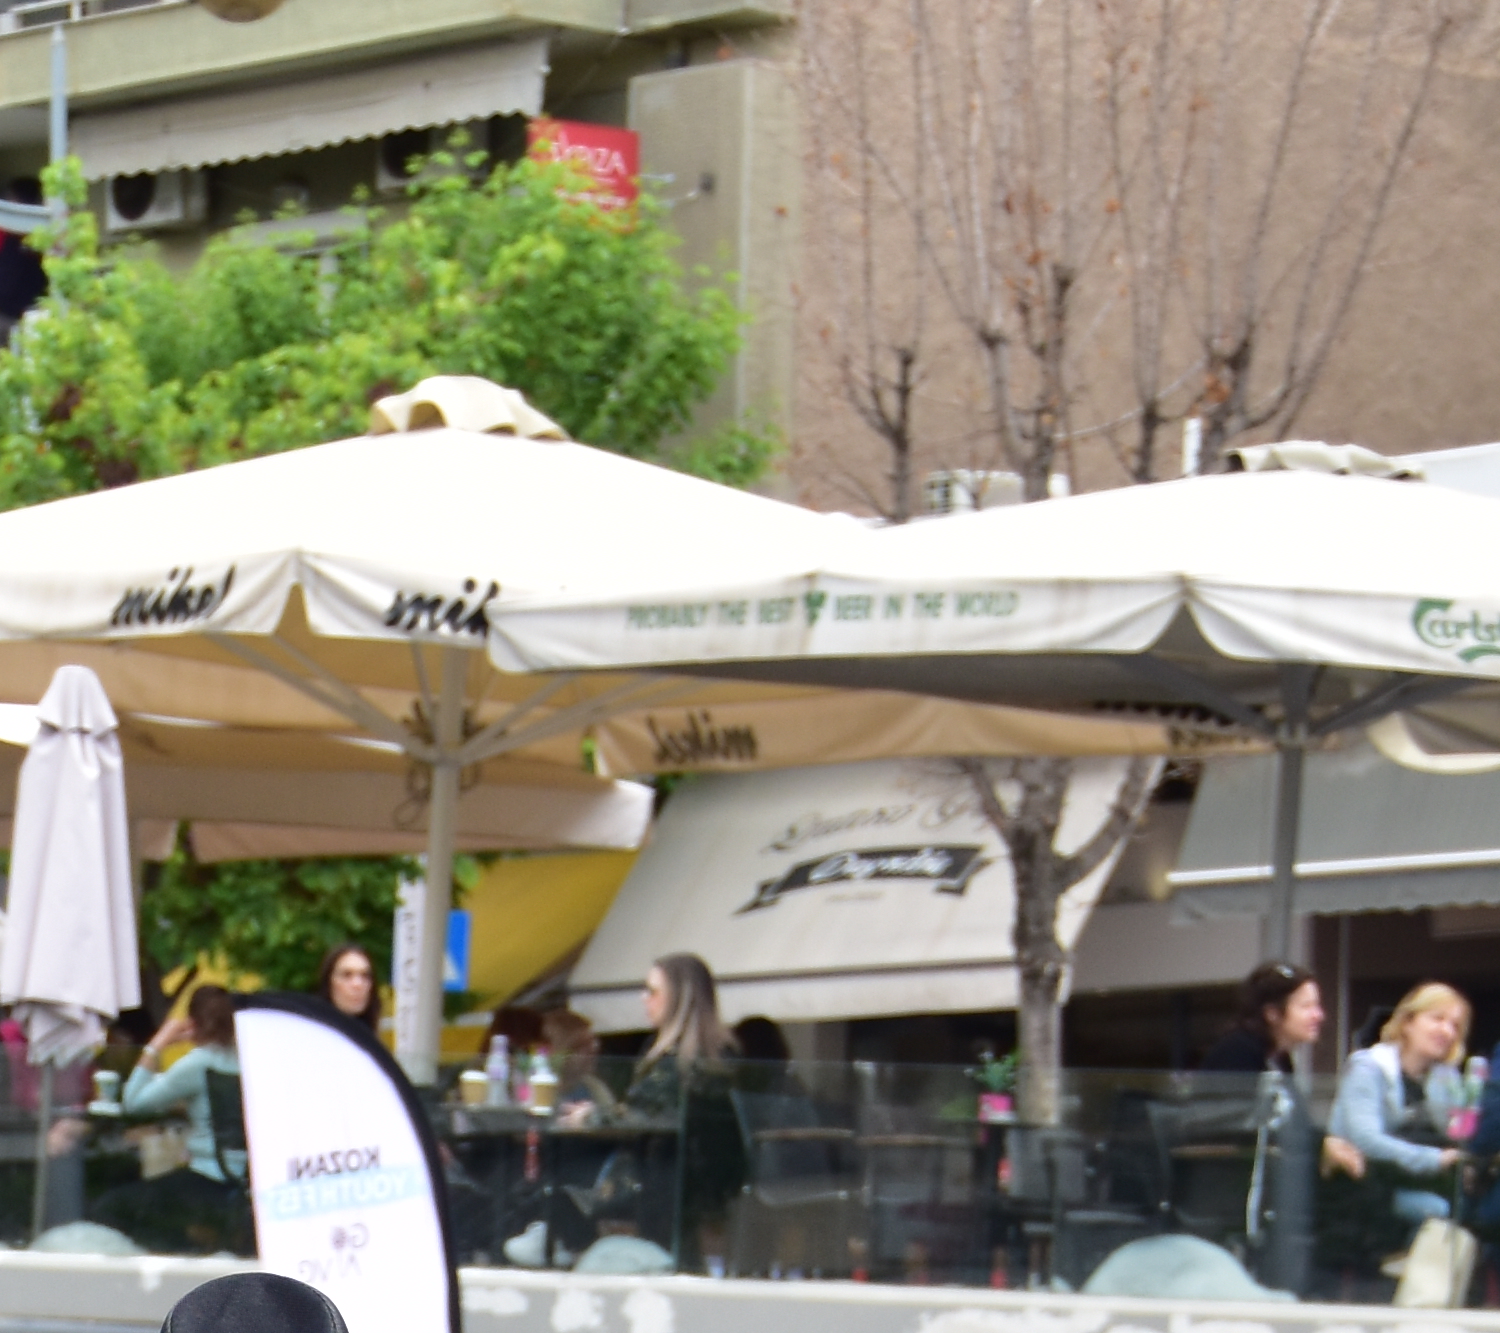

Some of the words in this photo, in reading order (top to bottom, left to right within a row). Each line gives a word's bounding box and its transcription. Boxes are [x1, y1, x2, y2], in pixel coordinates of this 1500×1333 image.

[110, 564, 236, 627] mikel
[627, 605, 707, 629] PROBABLY
[718, 600, 746, 625] THE
[758, 597, 795, 624] BEST
[915, 592, 946, 618] THE
